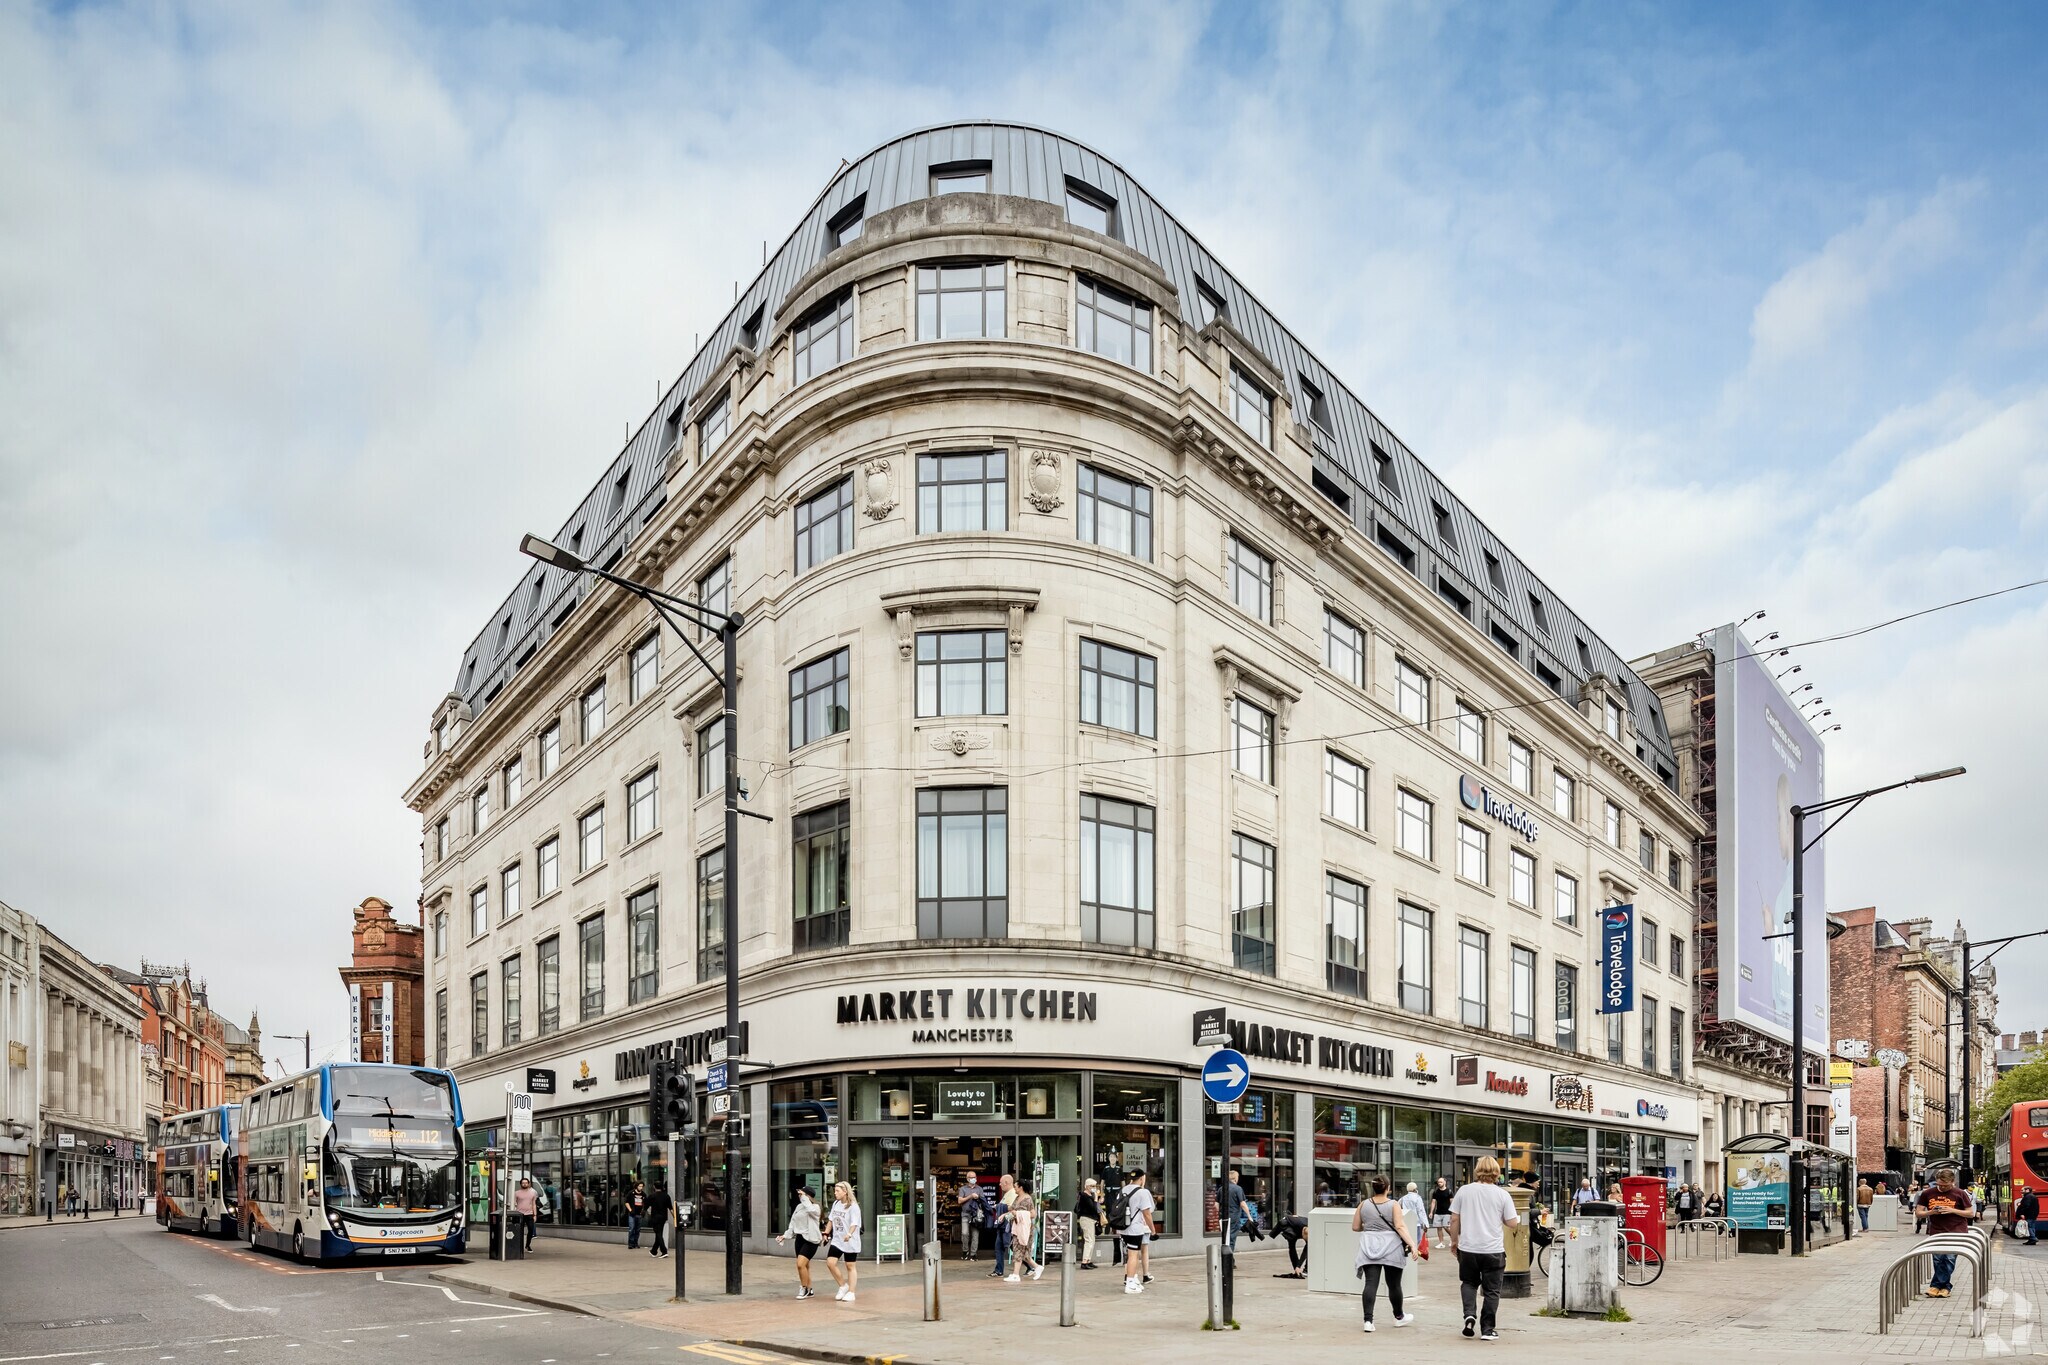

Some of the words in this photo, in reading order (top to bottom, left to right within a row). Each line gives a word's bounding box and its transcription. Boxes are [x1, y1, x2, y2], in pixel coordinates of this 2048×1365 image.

[1481, 786, 1539, 842] Travelodge
[1607, 931, 1626, 1006] Travelodge
[837, 989, 953, 1024] MARKET
[967, 988, 1096, 1021] KITCHEN
[1201, 1022, 1219, 1030] MARKET
[912, 1028, 1013, 1042] MANCHESTER
[1226, 1019, 1314, 1065] MARKET
[1319, 1036, 1394, 1077] KITCHEN
[615, 1040, 674, 1081] MARKET
[1406, 1068, 1438, 1083] Morrisons
[1485, 1071, 1528, 1096] Nando's
[948, 1090, 974, 1099] Lovely
[967, 1100, 982, 1108] you
[1646, 1102, 1668, 1121] Travelodge
[420, 1130, 438, 1144] 112
[1096, 1153, 1106, 1162] THE
